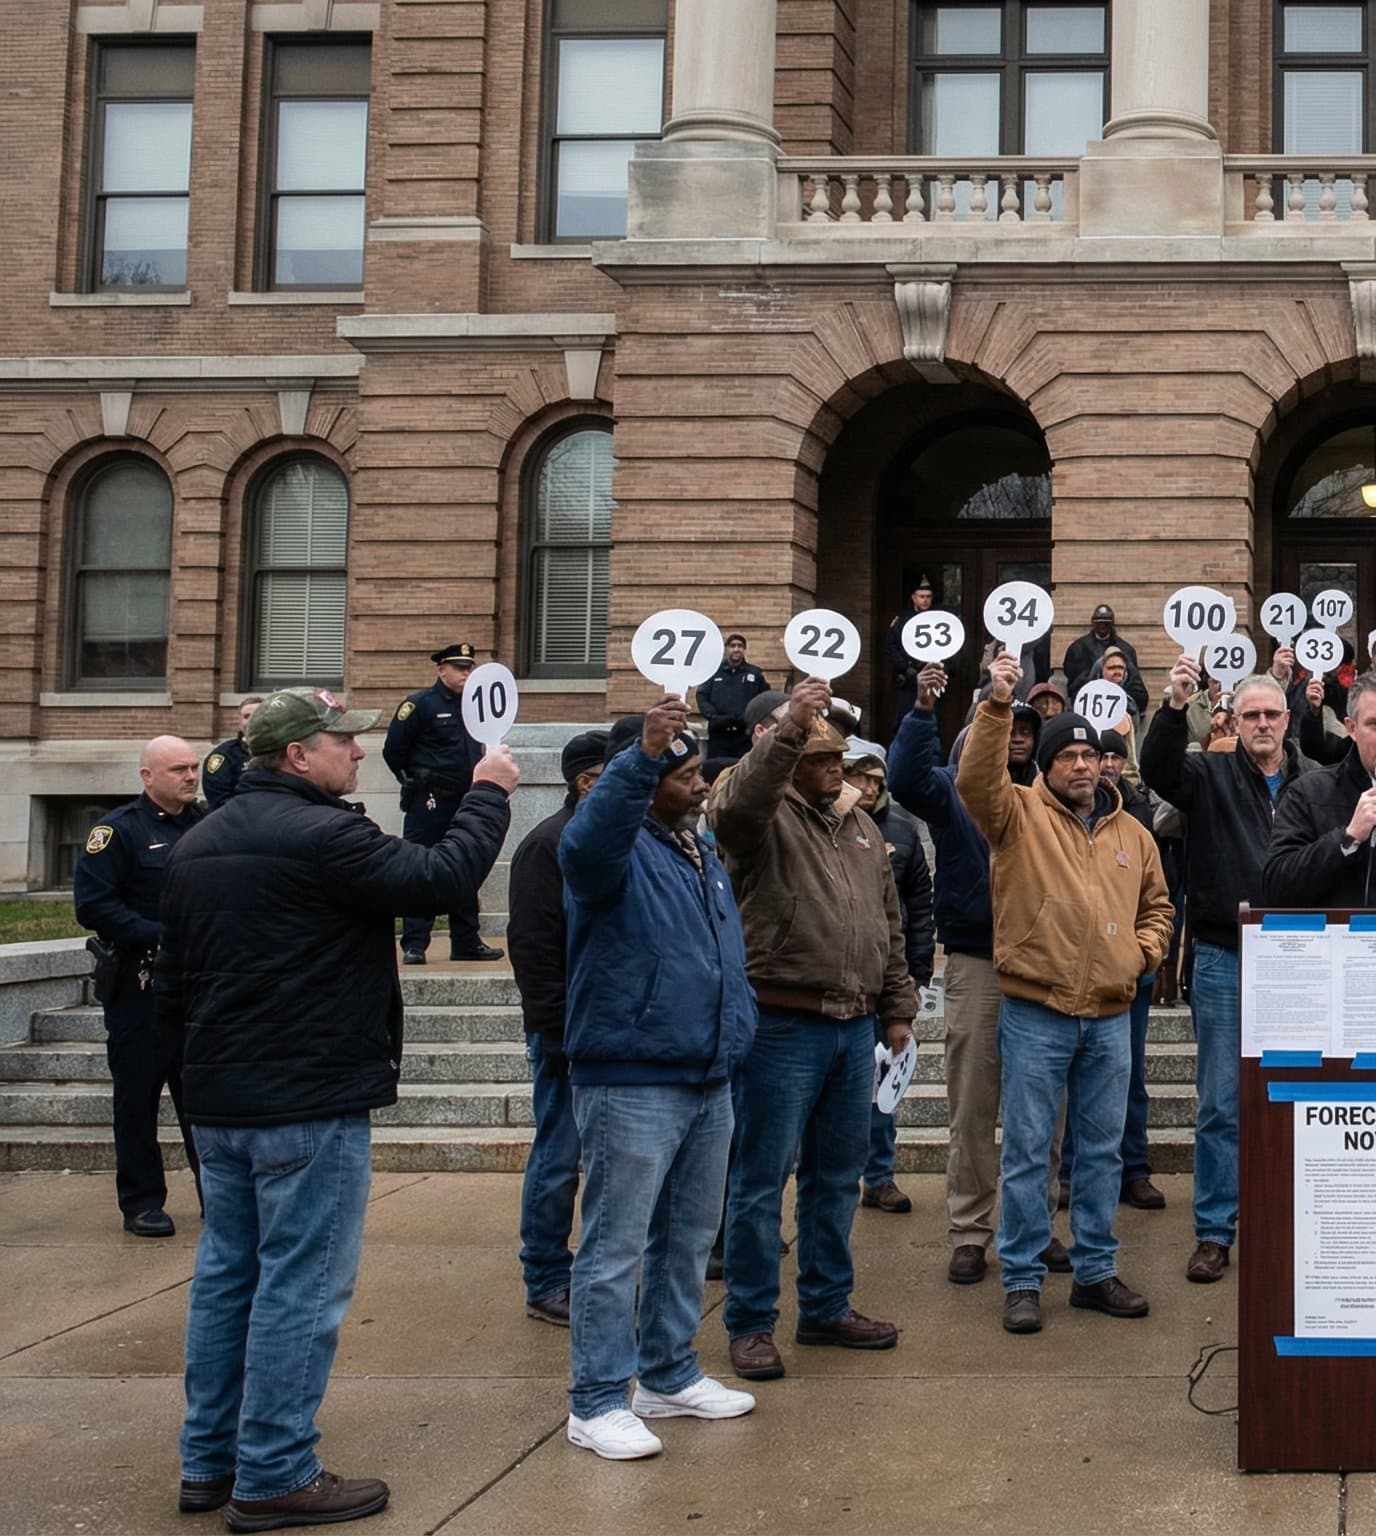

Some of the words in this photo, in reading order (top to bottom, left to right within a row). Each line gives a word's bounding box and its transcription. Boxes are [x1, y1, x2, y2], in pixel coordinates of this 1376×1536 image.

[998, 597, 1038, 627] 34
[1170, 600, 1226, 632] 100
[1270, 604, 1295, 625] 21
[1317, 599, 1346, 618] 107
[650, 629, 706, 666] 27
[798, 625, 845, 659] 22
[915, 623, 951, 648] 53
[1213, 646, 1245, 669] 29
[1306, 638, 1334, 661] 33
[471, 681, 506, 722] 10
